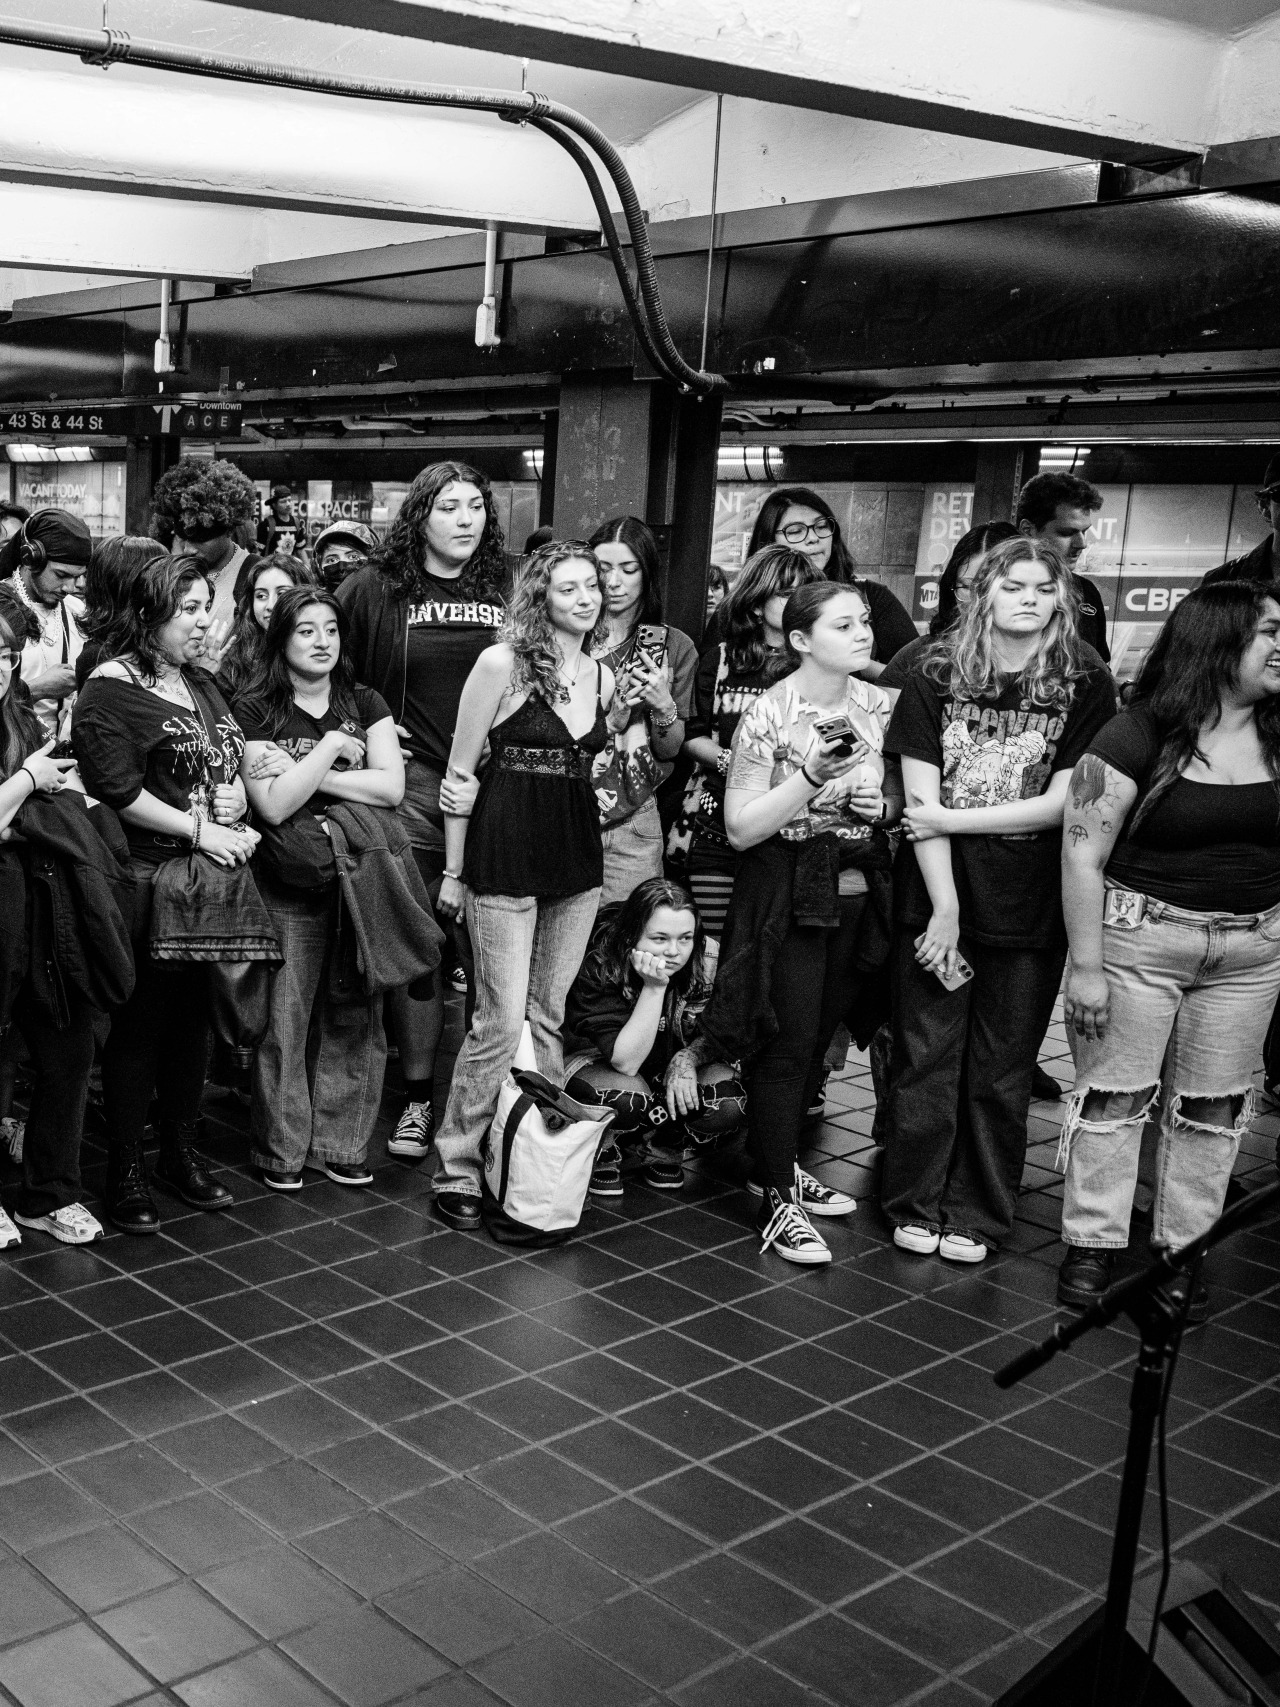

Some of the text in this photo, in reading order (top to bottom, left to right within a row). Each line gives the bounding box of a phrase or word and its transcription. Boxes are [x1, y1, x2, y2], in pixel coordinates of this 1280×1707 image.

[200, 402, 242, 410] Downtown
[8, 413, 26, 428] 43
[31, 415, 46, 429] St
[51, 415, 61, 429] &
[66, 415, 84, 430] 44
[89, 416, 103, 430] St
[187, 415, 228, 427] A C E
[20, 483, 55, 498] VACANT
[318, 500, 359, 519] SPACE
